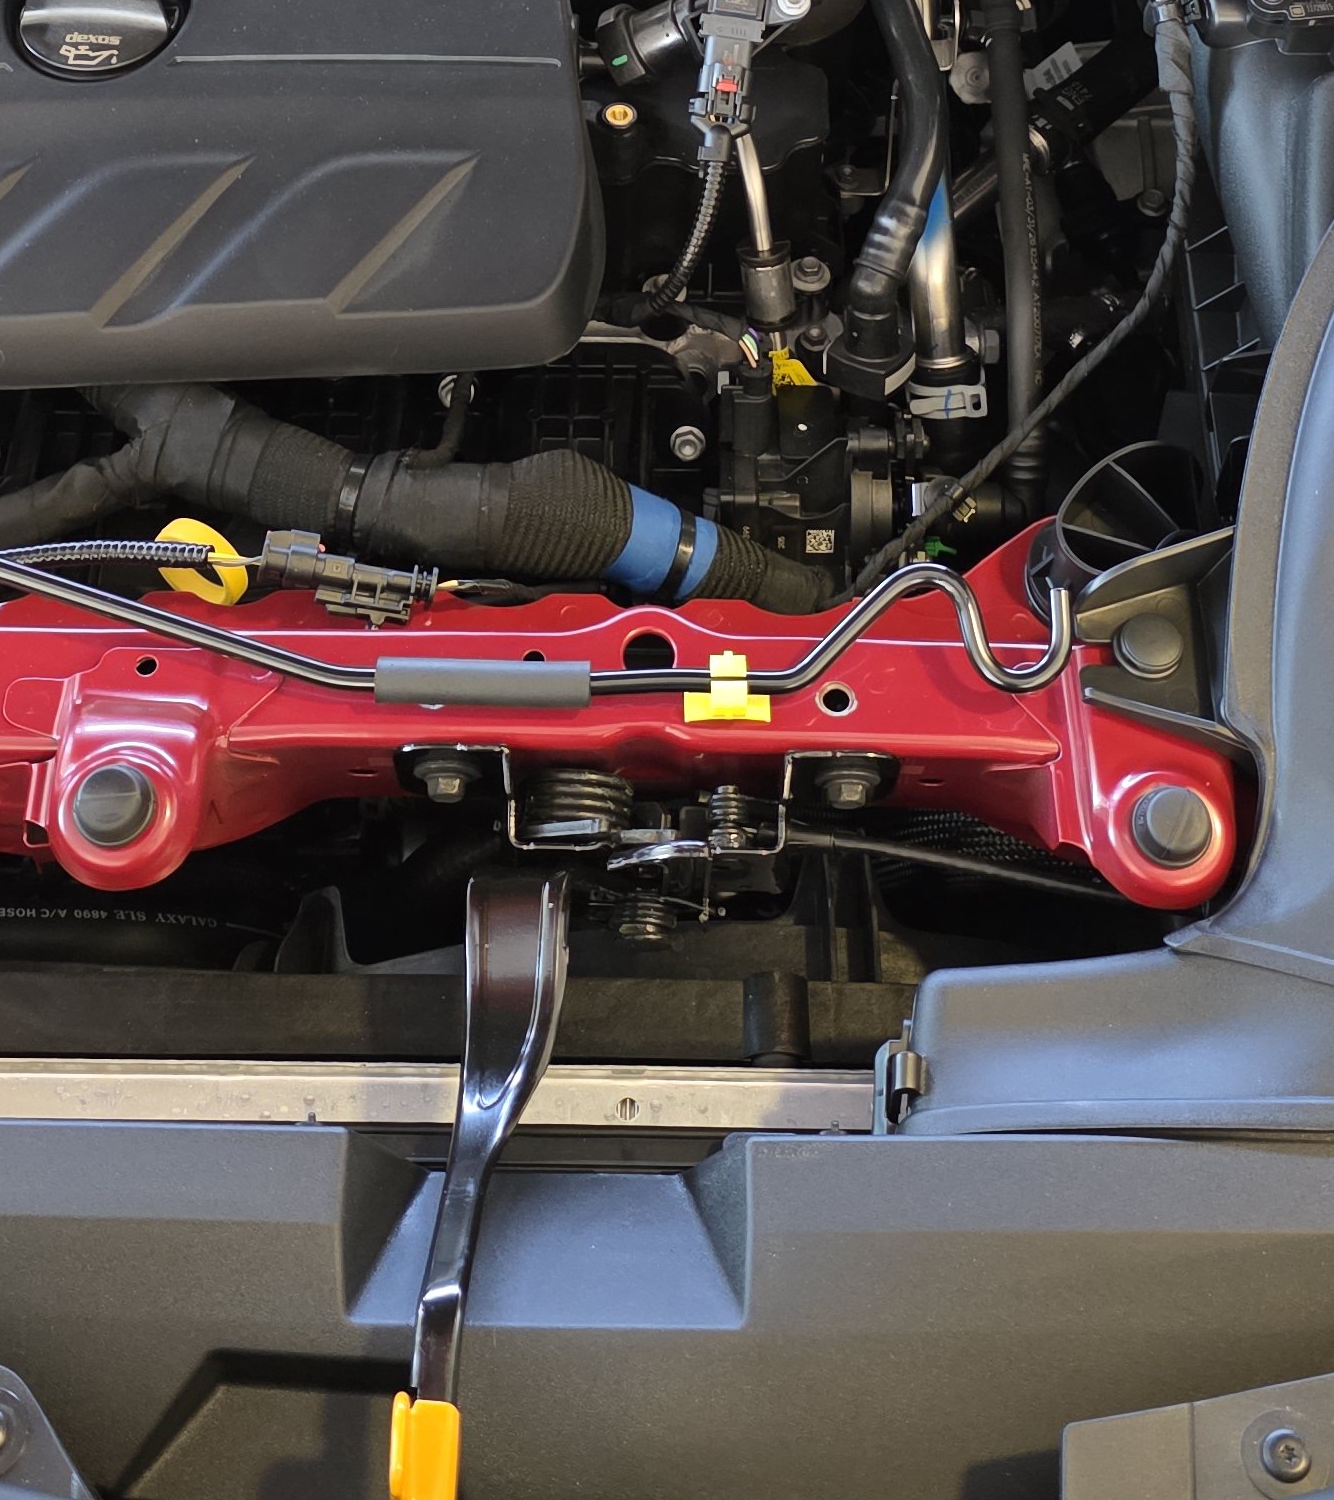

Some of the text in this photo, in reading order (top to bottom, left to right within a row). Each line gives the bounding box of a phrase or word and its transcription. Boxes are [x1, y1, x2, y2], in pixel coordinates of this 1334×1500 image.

[64, 31, 123, 46] dexos
[40, 908, 68, 919] A/C
[73, 909, 109, 920] 4890
[115, 909, 147, 922] SLE
[154, 912, 218, 928] GALAXY
